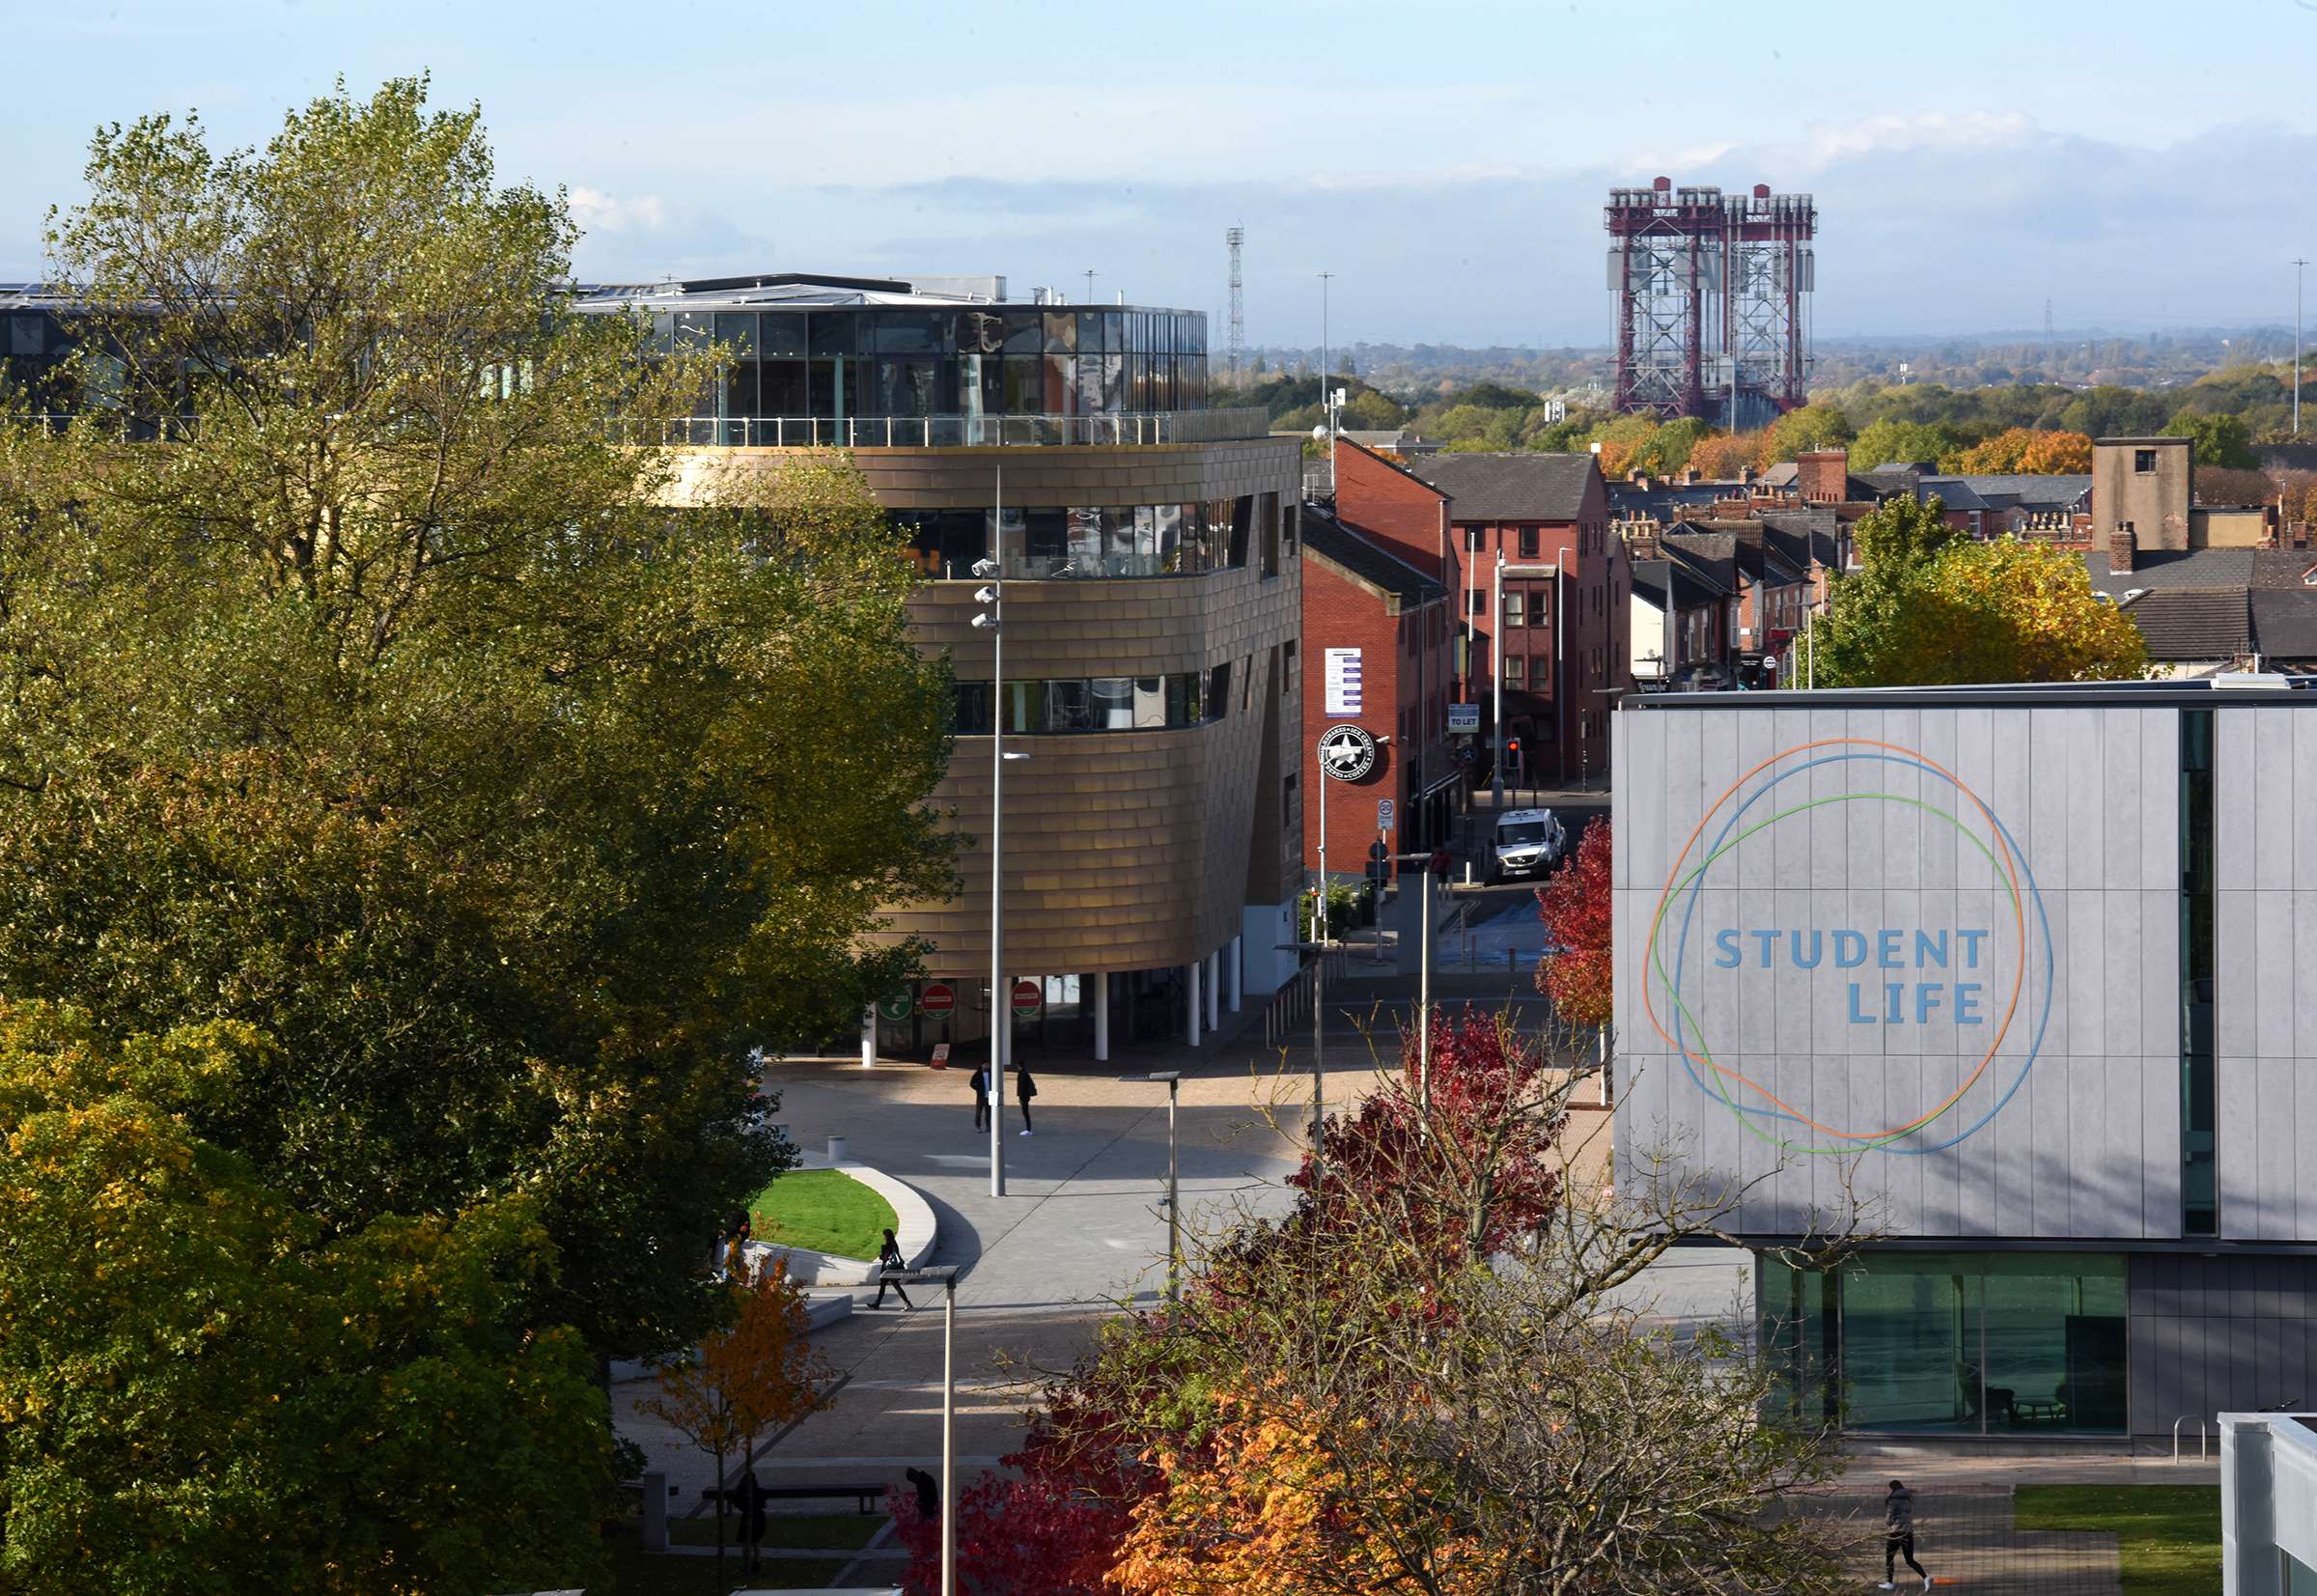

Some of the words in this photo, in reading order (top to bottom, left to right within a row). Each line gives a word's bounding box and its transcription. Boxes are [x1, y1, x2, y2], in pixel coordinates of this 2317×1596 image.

[1351, 728, 1362, 737] ICE
[1361, 735, 1372, 757] CREAM
[1348, 762, 1369, 777] COFFEE
[1714, 929, 1990, 968] STUDENT
[1848, 983, 1983, 1024] LIFE
